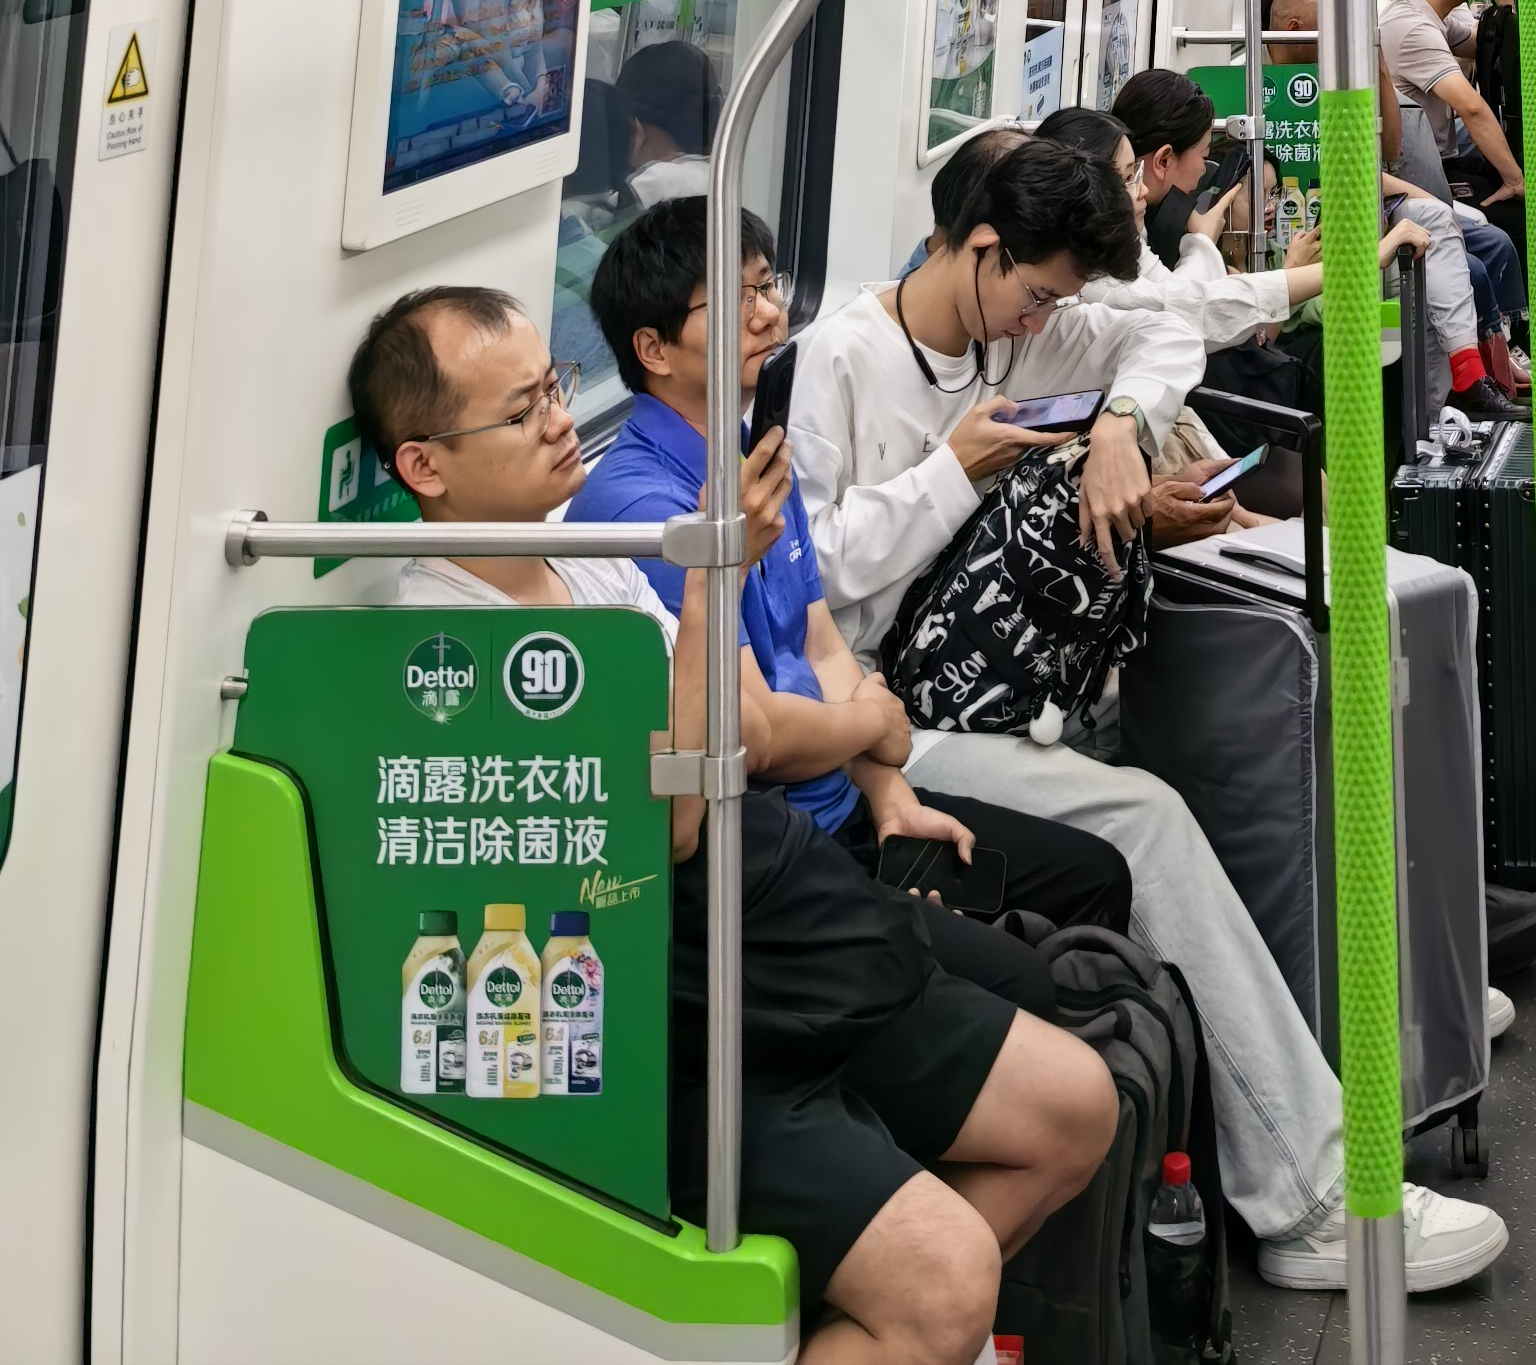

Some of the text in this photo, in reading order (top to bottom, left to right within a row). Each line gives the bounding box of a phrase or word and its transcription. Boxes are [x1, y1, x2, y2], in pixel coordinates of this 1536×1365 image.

[1294, 80, 1313, 98] 90
[407, 664, 474, 689] Dettol
[521, 649, 567, 694] 90
[376, 754, 609, 804] 滴露洗衣机
[376, 815, 609, 866] 清洁除菌液
